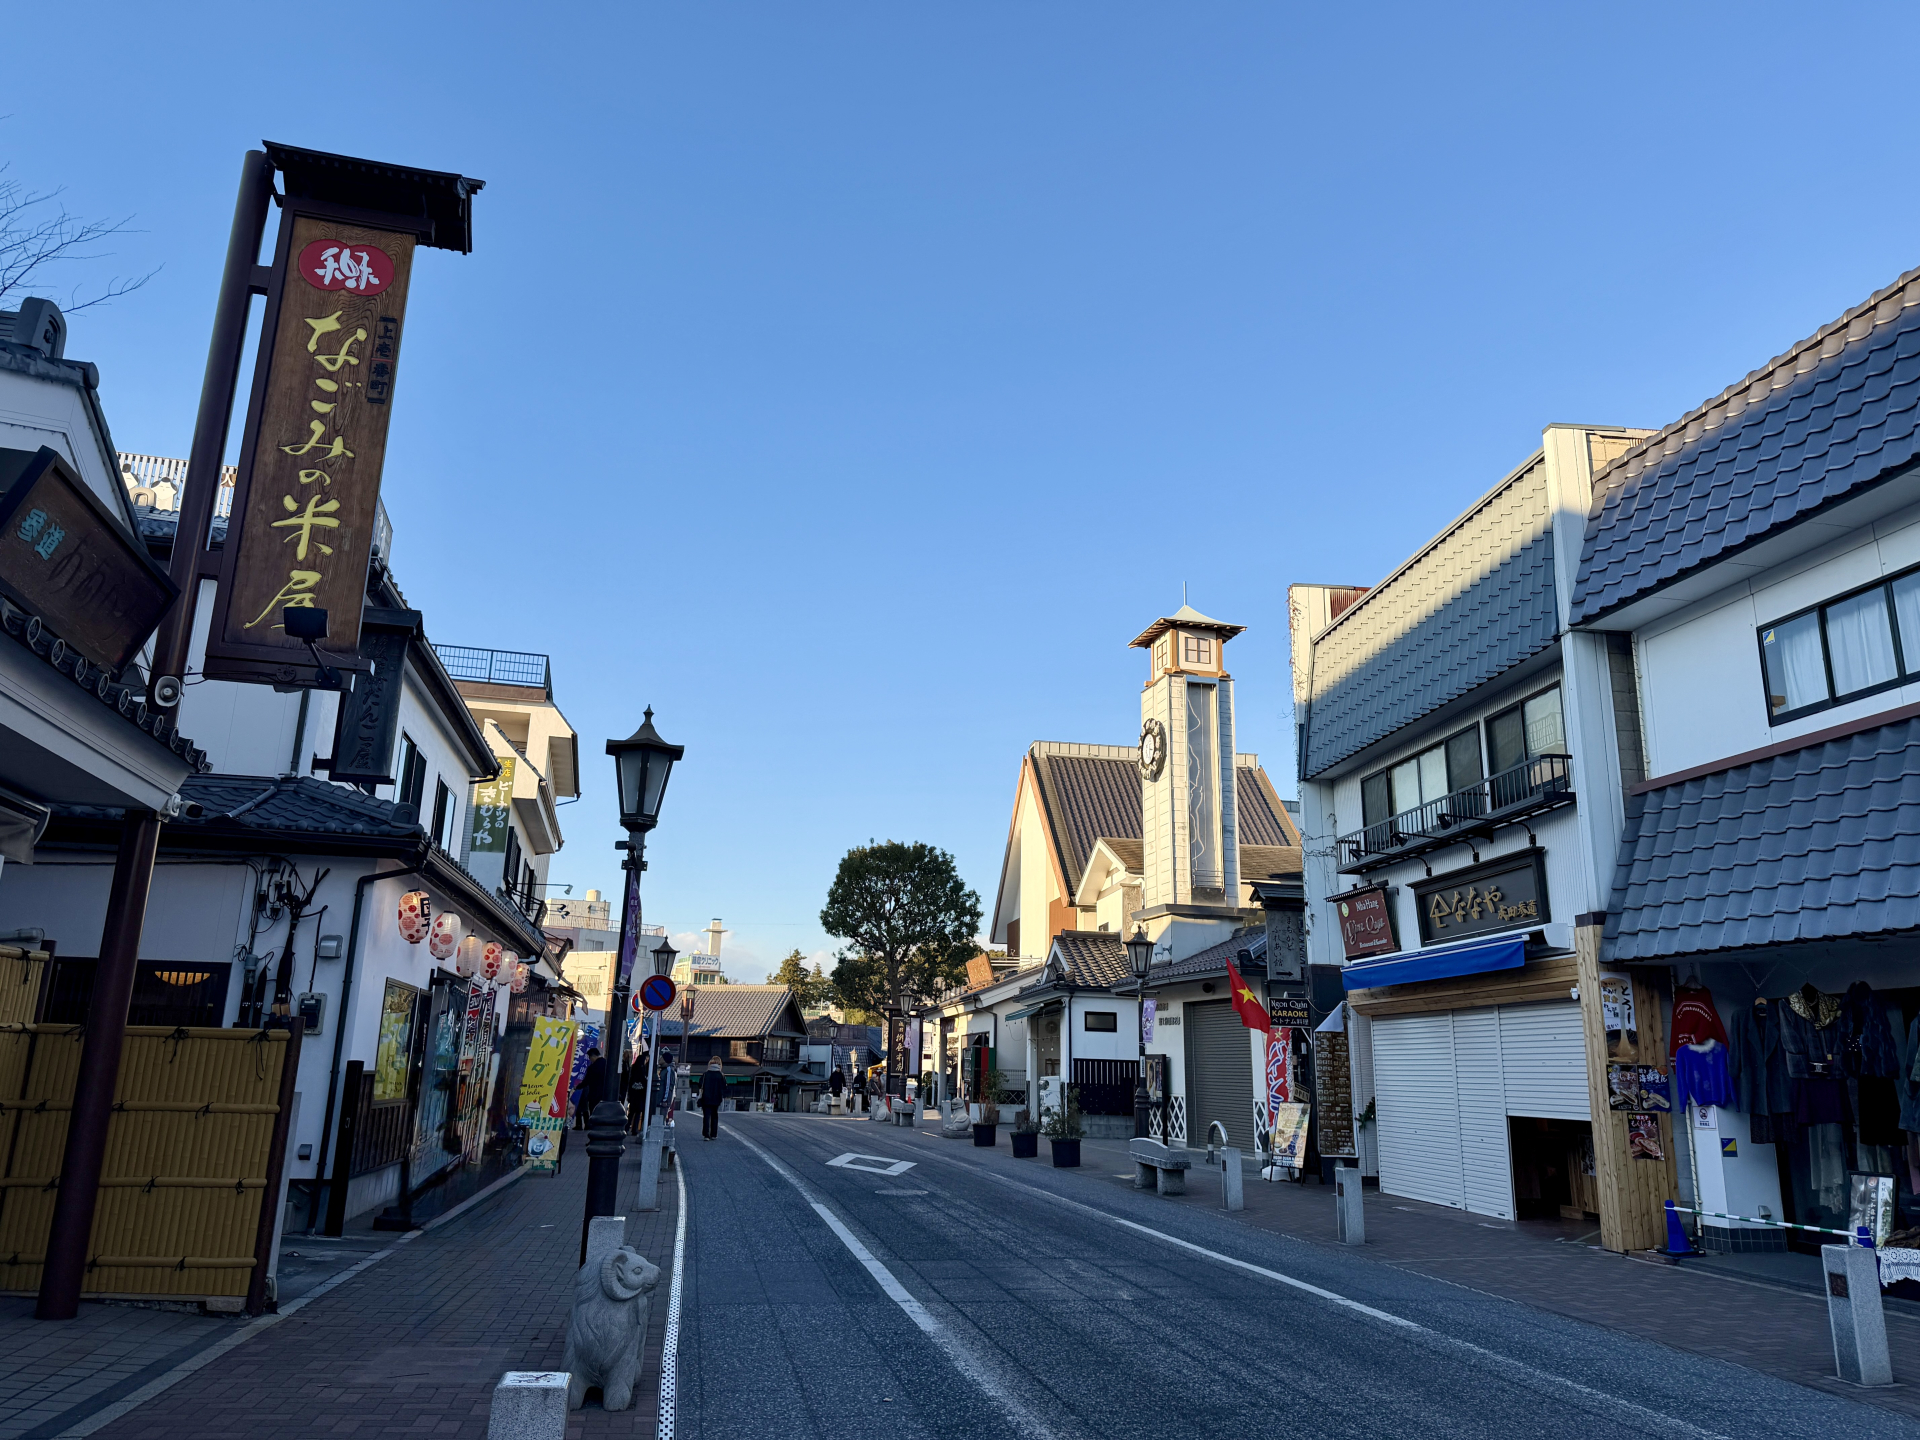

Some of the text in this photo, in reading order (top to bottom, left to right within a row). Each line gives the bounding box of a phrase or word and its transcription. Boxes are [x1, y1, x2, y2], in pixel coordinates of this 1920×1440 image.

[370, 325, 393, 396] 上壱番町
[243, 311, 367, 629] なごみの米屋
[16, 508, 66, 561] 参道
[473, 785, 497, 846] きむらや
[1272, 926, 1283, 967] ふれあい館
[1286, 916, 1295, 951] まちかど
[1271, 999, 1288, 1010] Ngon
[1271, 1010, 1309, 1018] KARAOKE
[1272, 1018, 1309, 1026] ベトナム料理
[531, 1034, 550, 1078] ソーダ
